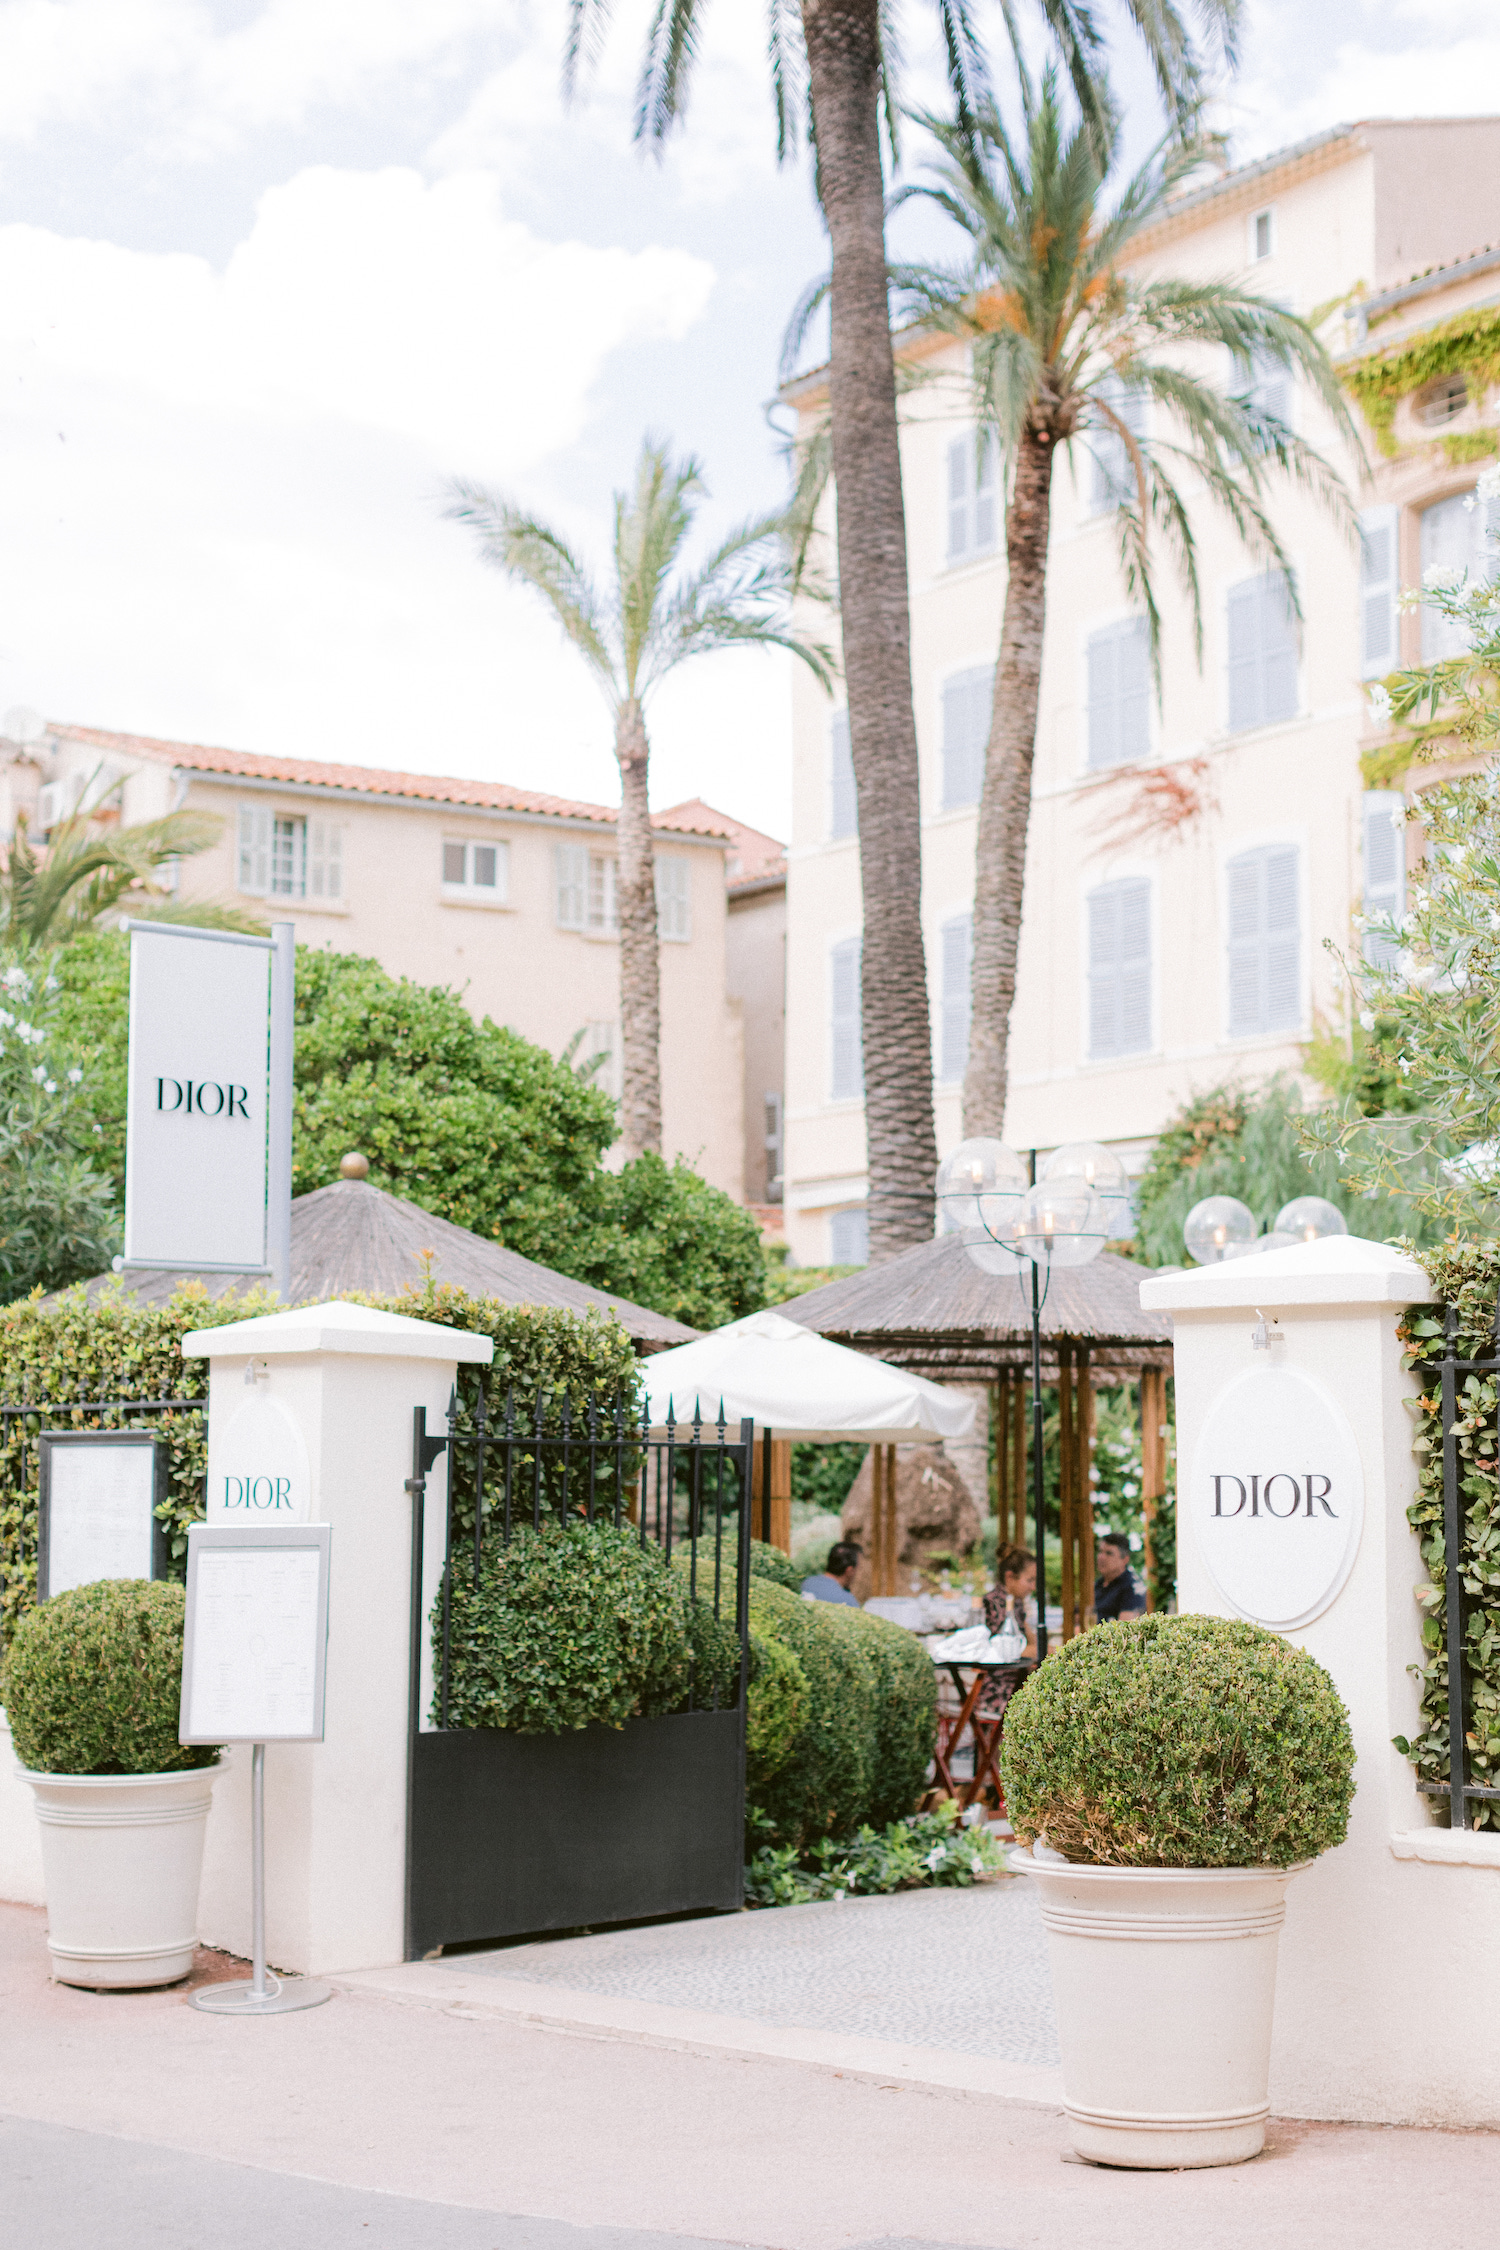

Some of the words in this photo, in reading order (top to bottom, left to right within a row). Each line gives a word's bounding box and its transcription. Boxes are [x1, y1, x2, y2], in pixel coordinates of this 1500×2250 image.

[157, 1077, 251, 1119] DIOR
[223, 1476, 293, 1510] DIOR
[1210, 1474, 1339, 1518] DIOR
